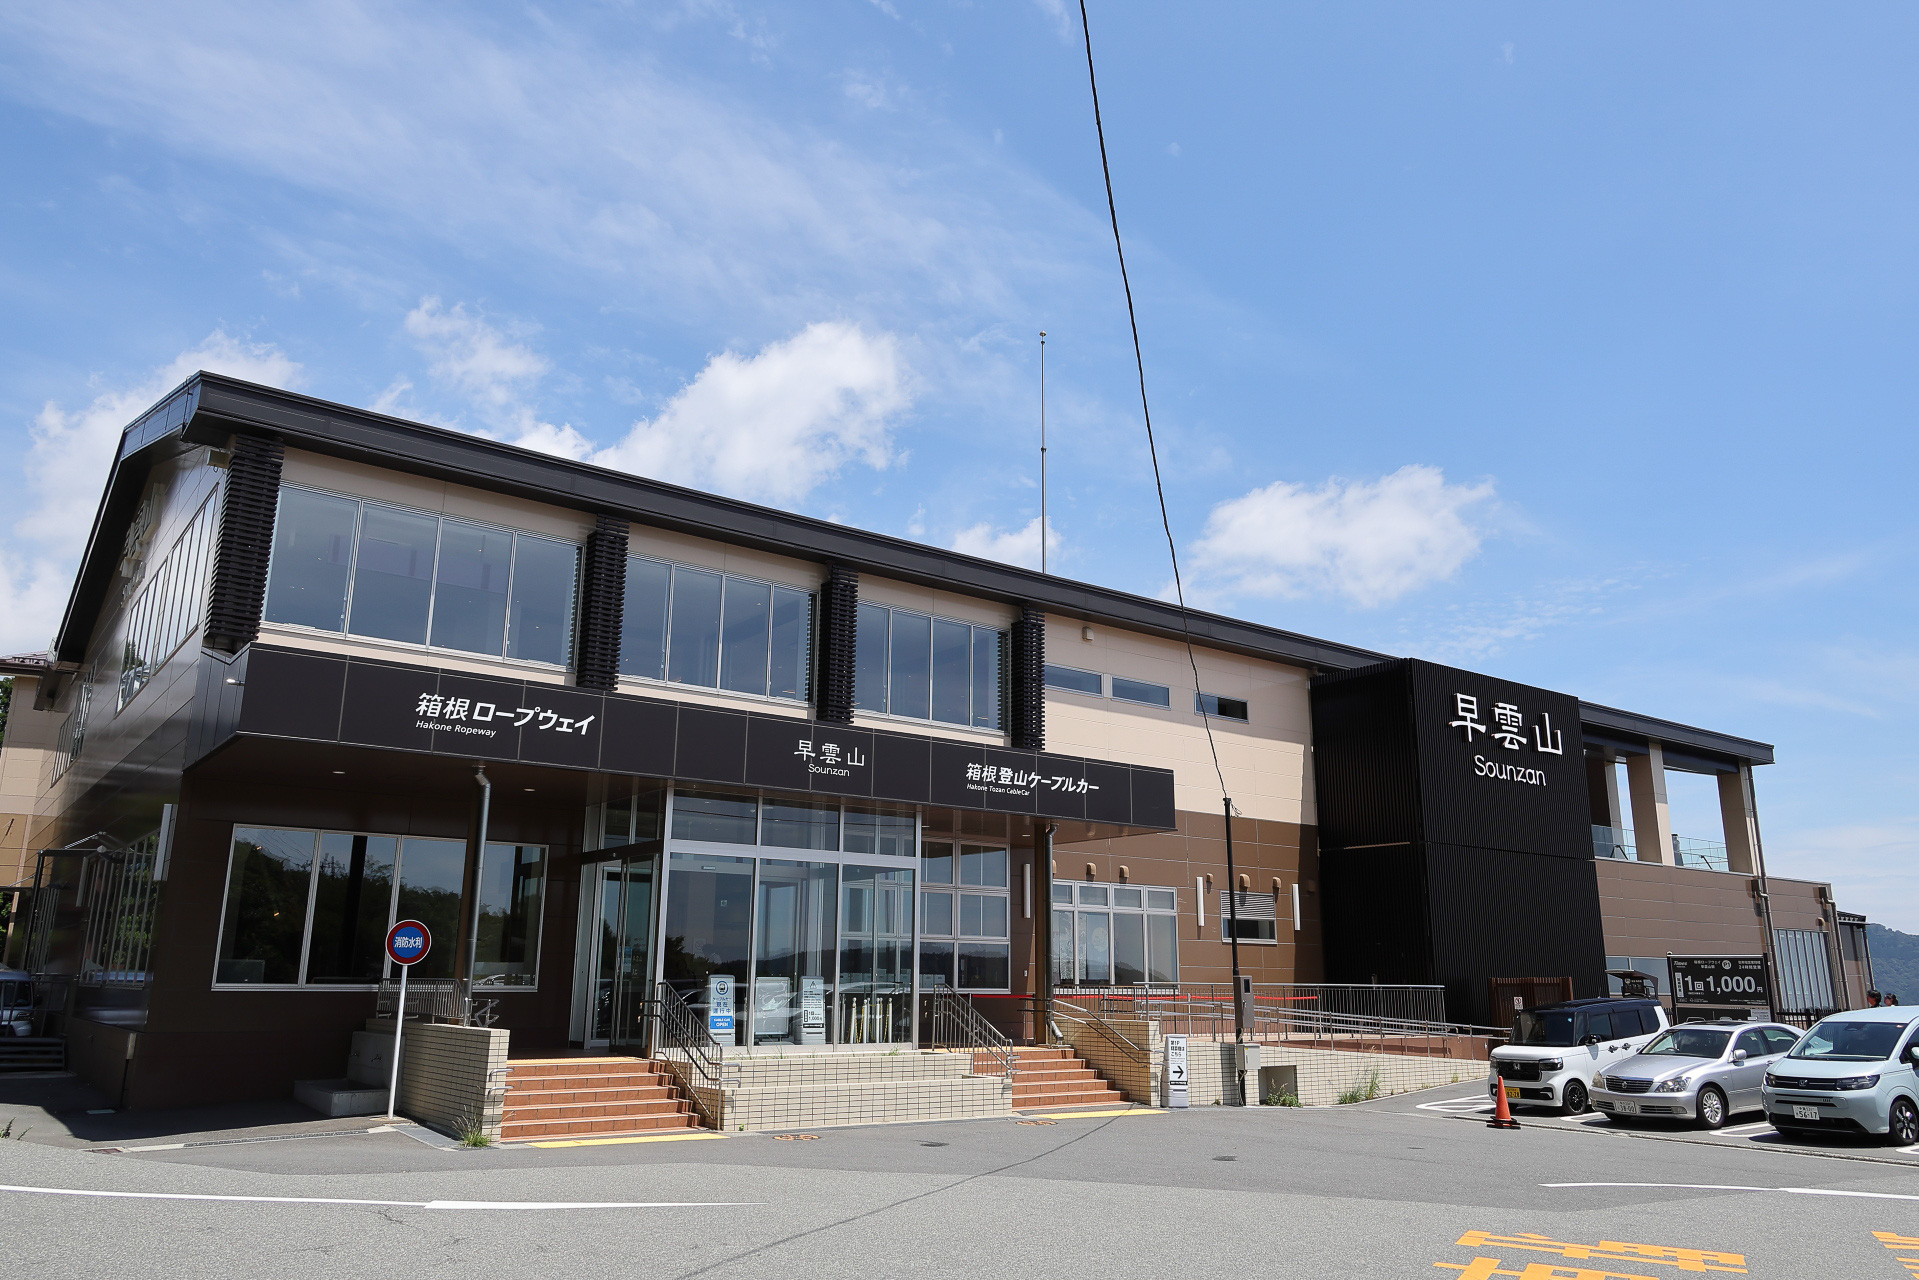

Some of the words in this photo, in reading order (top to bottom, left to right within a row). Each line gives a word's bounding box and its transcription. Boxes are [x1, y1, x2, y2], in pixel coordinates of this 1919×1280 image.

[415, 692, 596, 736] 箱根ロープウェイ
[1449, 693, 1563, 756] 早雲山
[415, 719, 452, 732] Hakone
[454, 724, 497, 738] Ropeway
[793, 739, 865, 767] 早雲山
[808, 763, 850, 777] Sounzan
[965, 762, 1099, 794] 箱根登山ケーブルカー
[1474, 754, 1547, 787] Sounzan
[966, 783, 987, 792] Hakone
[987, 785, 1006, 794] Tozan
[394, 937, 423, 948] 消防水利
